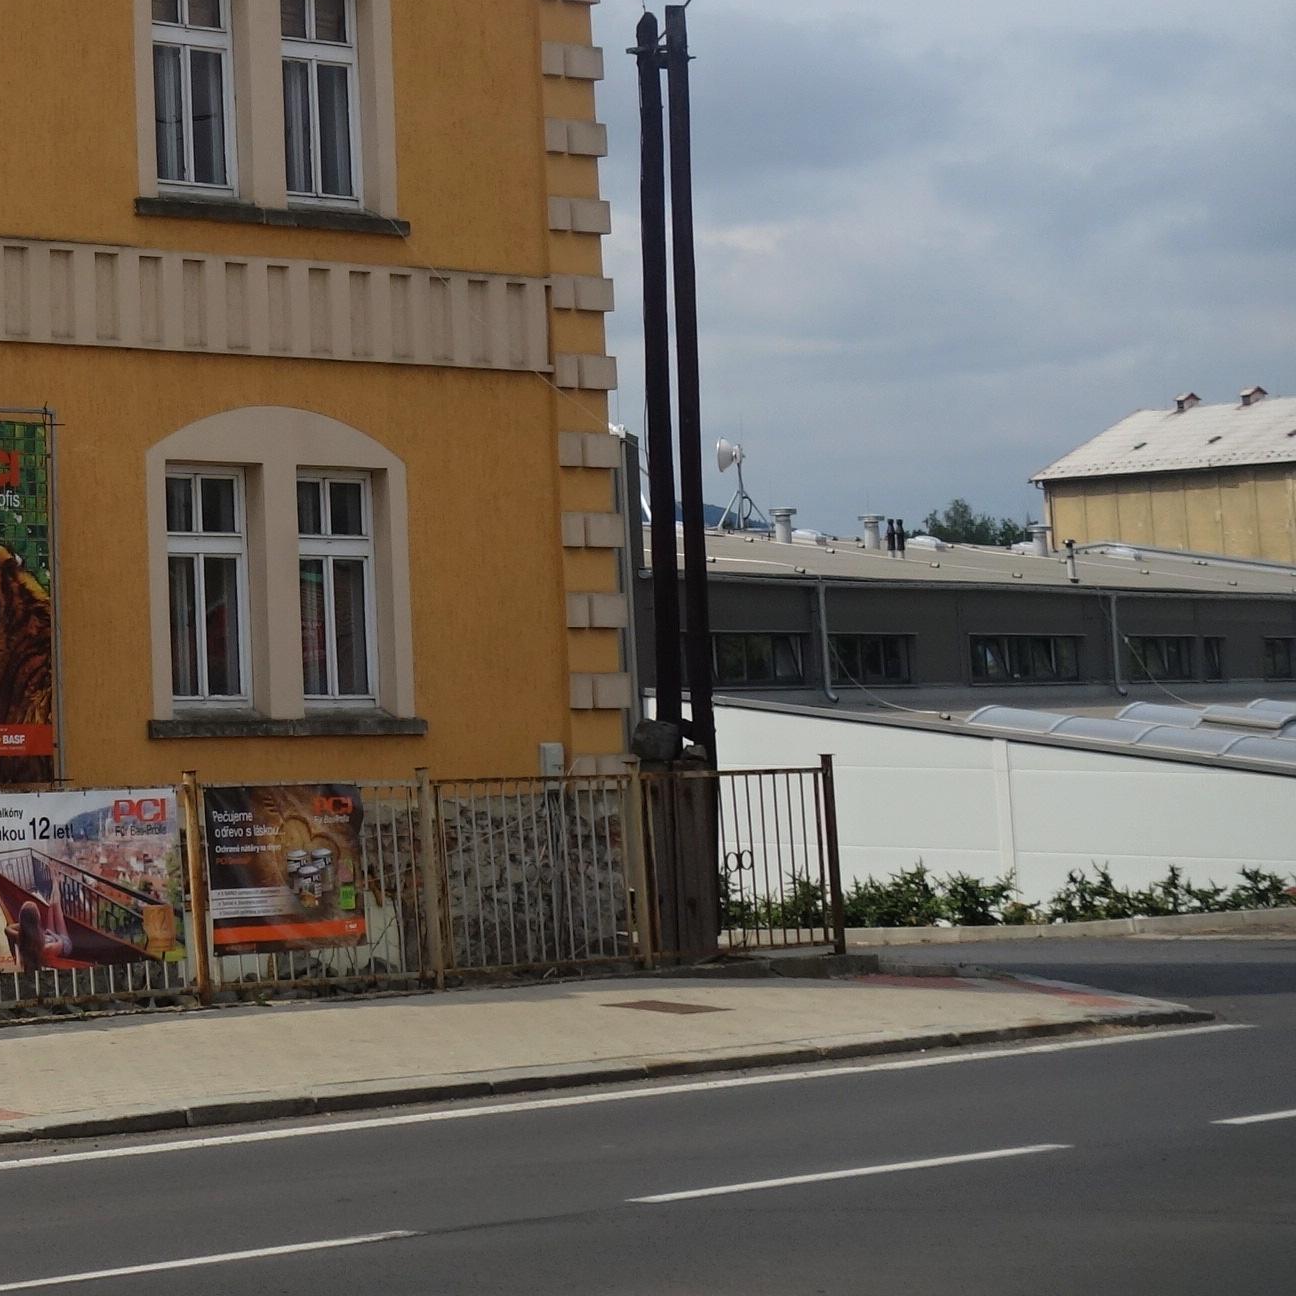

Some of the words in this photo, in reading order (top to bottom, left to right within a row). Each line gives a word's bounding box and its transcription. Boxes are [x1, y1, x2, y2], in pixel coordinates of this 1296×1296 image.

[2, 734, 25, 744] BASF
[114, 799, 166, 823] PCI
[213, 810, 253, 824] Pečujeme
[29, 817, 50, 840] 12
[53, 823, 73, 840] let!
[222, 826, 243, 837] dřevo
